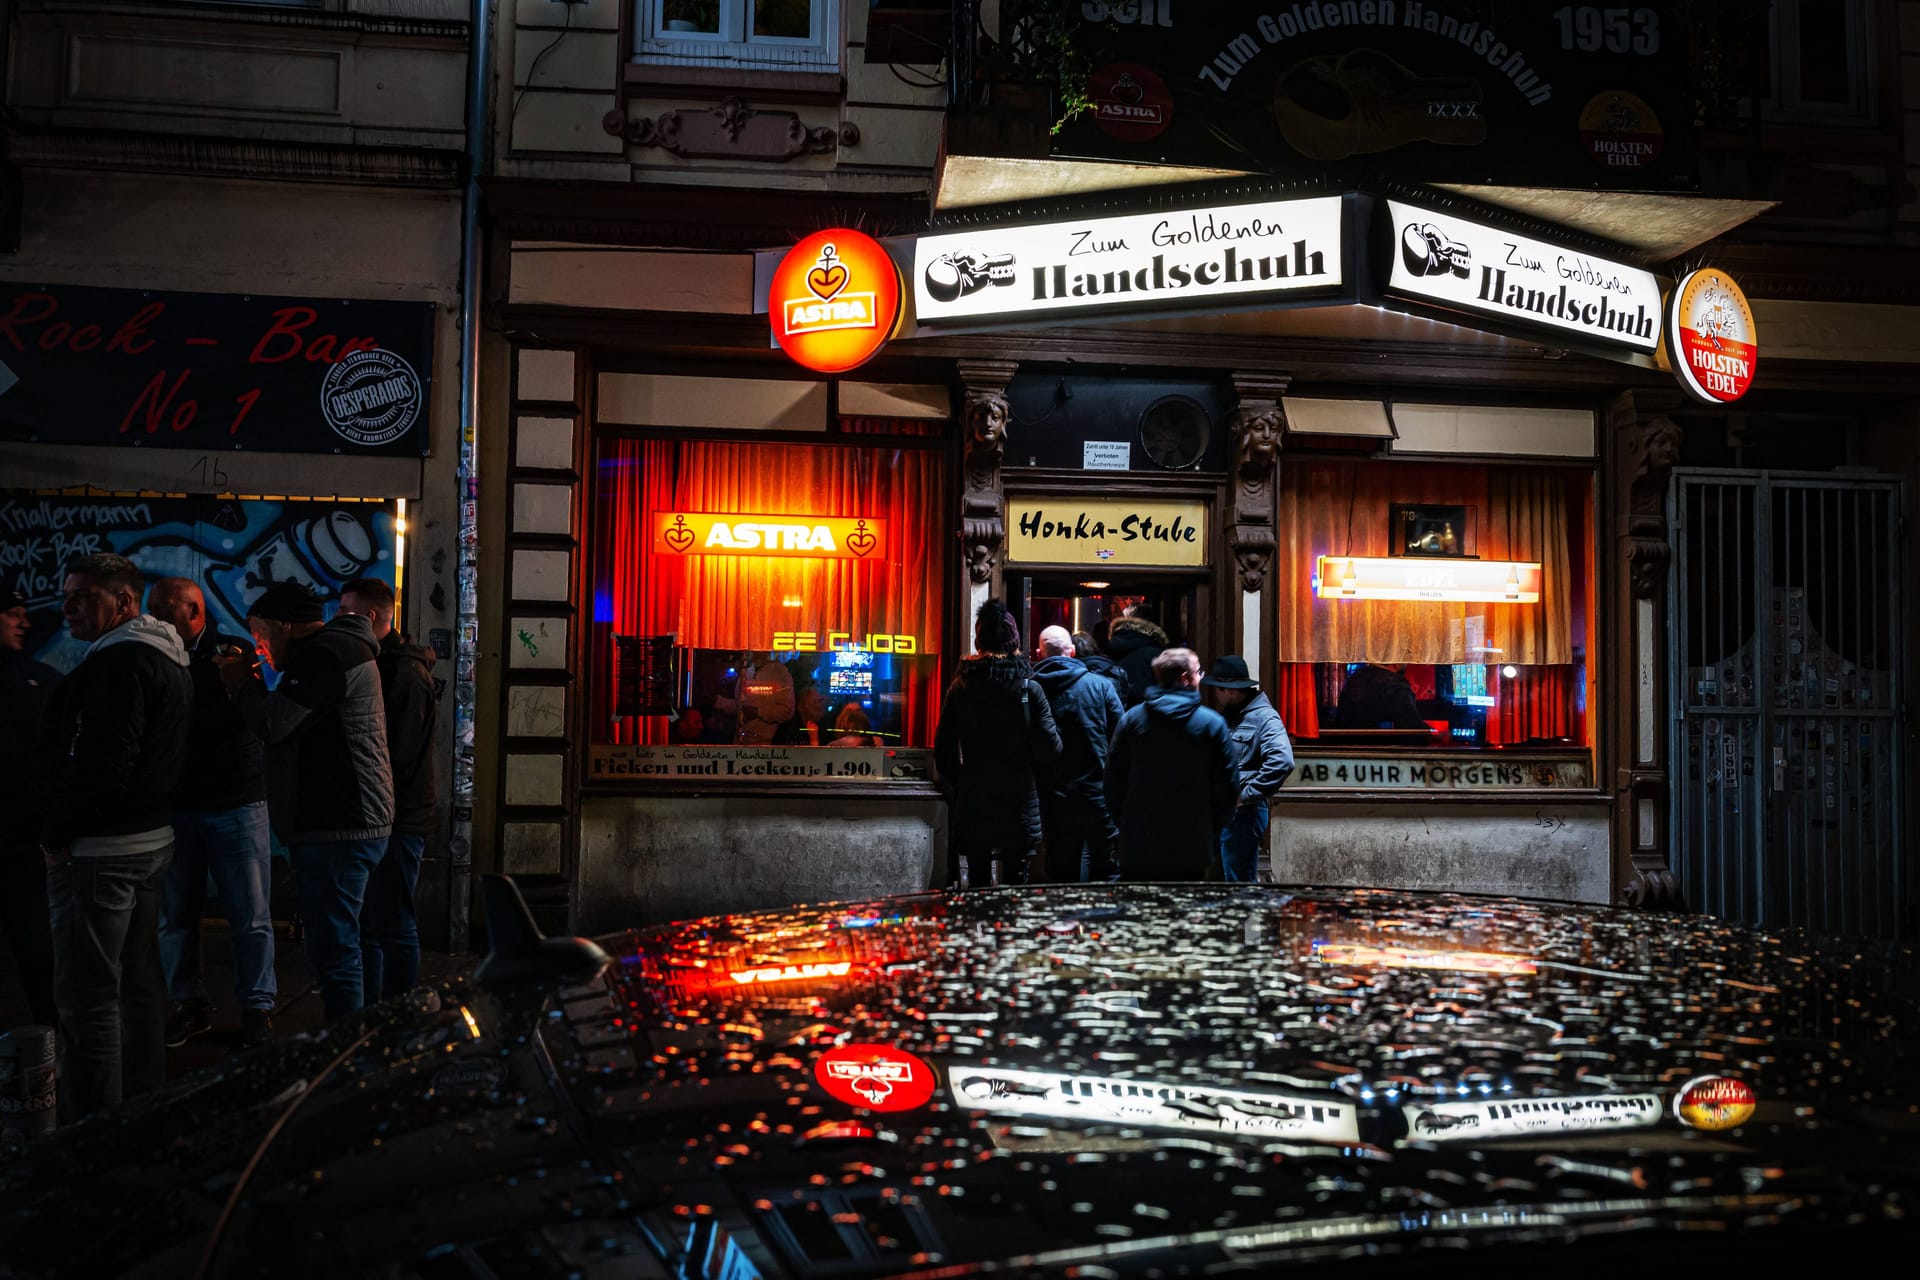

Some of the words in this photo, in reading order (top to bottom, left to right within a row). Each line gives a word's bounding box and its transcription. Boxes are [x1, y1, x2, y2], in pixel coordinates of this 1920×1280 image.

[1552, 5, 1662, 57] 1953
[1199, 31, 1262, 93] Zum
[1256, 0, 1395, 45] Goldenen
[1402, 0, 1553, 107] Handschuh
[1100, 104, 1157, 119] ASTRA
[1594, 139, 1653, 154] HOLSTEN
[1607, 154, 1641, 167] EDEL
[1068, 230, 1131, 256] Zum
[1151, 214, 1284, 246] Goldenen
[1032, 240, 1328, 300] Handschuh
[1503, 242, 1546, 274] Zum
[1556, 255, 1633, 296] Goldenen
[790, 298, 868, 325] ASTRA
[1476, 265, 1653, 340] Handschuh
[0, 292, 166, 355] Rock
[249, 306, 379, 364] Bar
[1692, 348, 1750, 379] HOLSTEN
[331, 375, 412, 419] DESPERADOS
[1706, 371, 1738, 395] EDEL
[119, 369, 197, 434] No
[230, 387, 261, 434] 1
[190, 455, 228, 487] 1b
[704, 522, 837, 551] ASTRA
[1019, 510, 1196, 543] Honka-Stube
[594, 759, 669, 775] Ficken
[677, 760, 719, 775] und
[727, 760, 805, 776] Lecken
[682, 748, 729, 760] Goldenen
[735, 748, 791, 760] Handschuh
[1300, 764, 1330, 782] AB
[1336, 763, 1349, 782] 4
[1354, 765, 1401, 783] UHR
[1410, 765, 1524, 785] MORGENS
